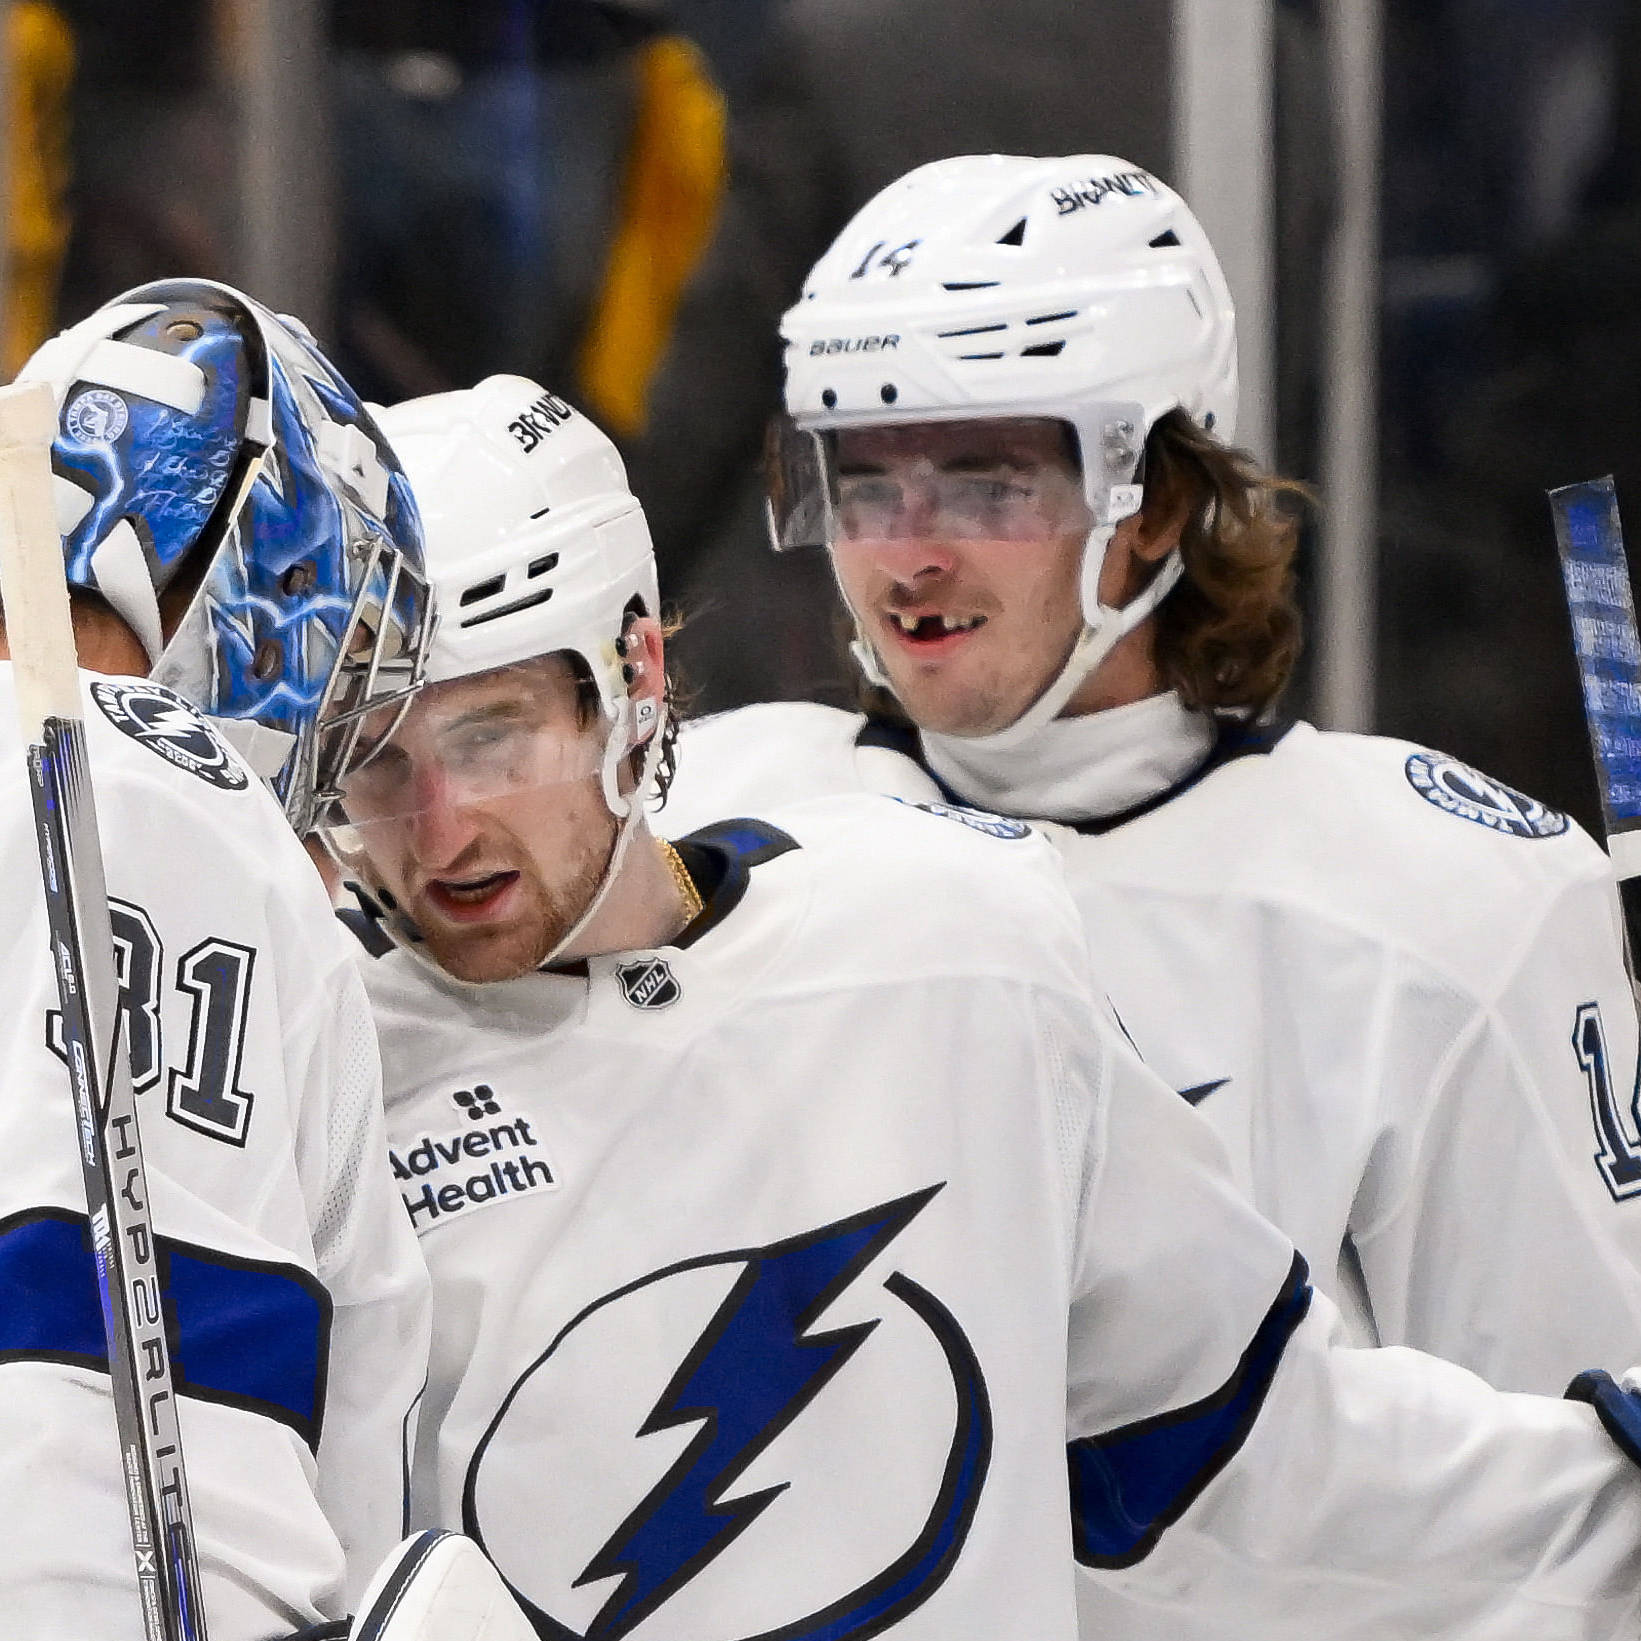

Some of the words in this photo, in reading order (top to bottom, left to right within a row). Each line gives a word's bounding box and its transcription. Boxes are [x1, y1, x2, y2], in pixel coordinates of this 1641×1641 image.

[635, 969, 664, 1003] NHL
[389, 1117, 537, 1181] Advent
[401, 1155, 554, 1229] Health
